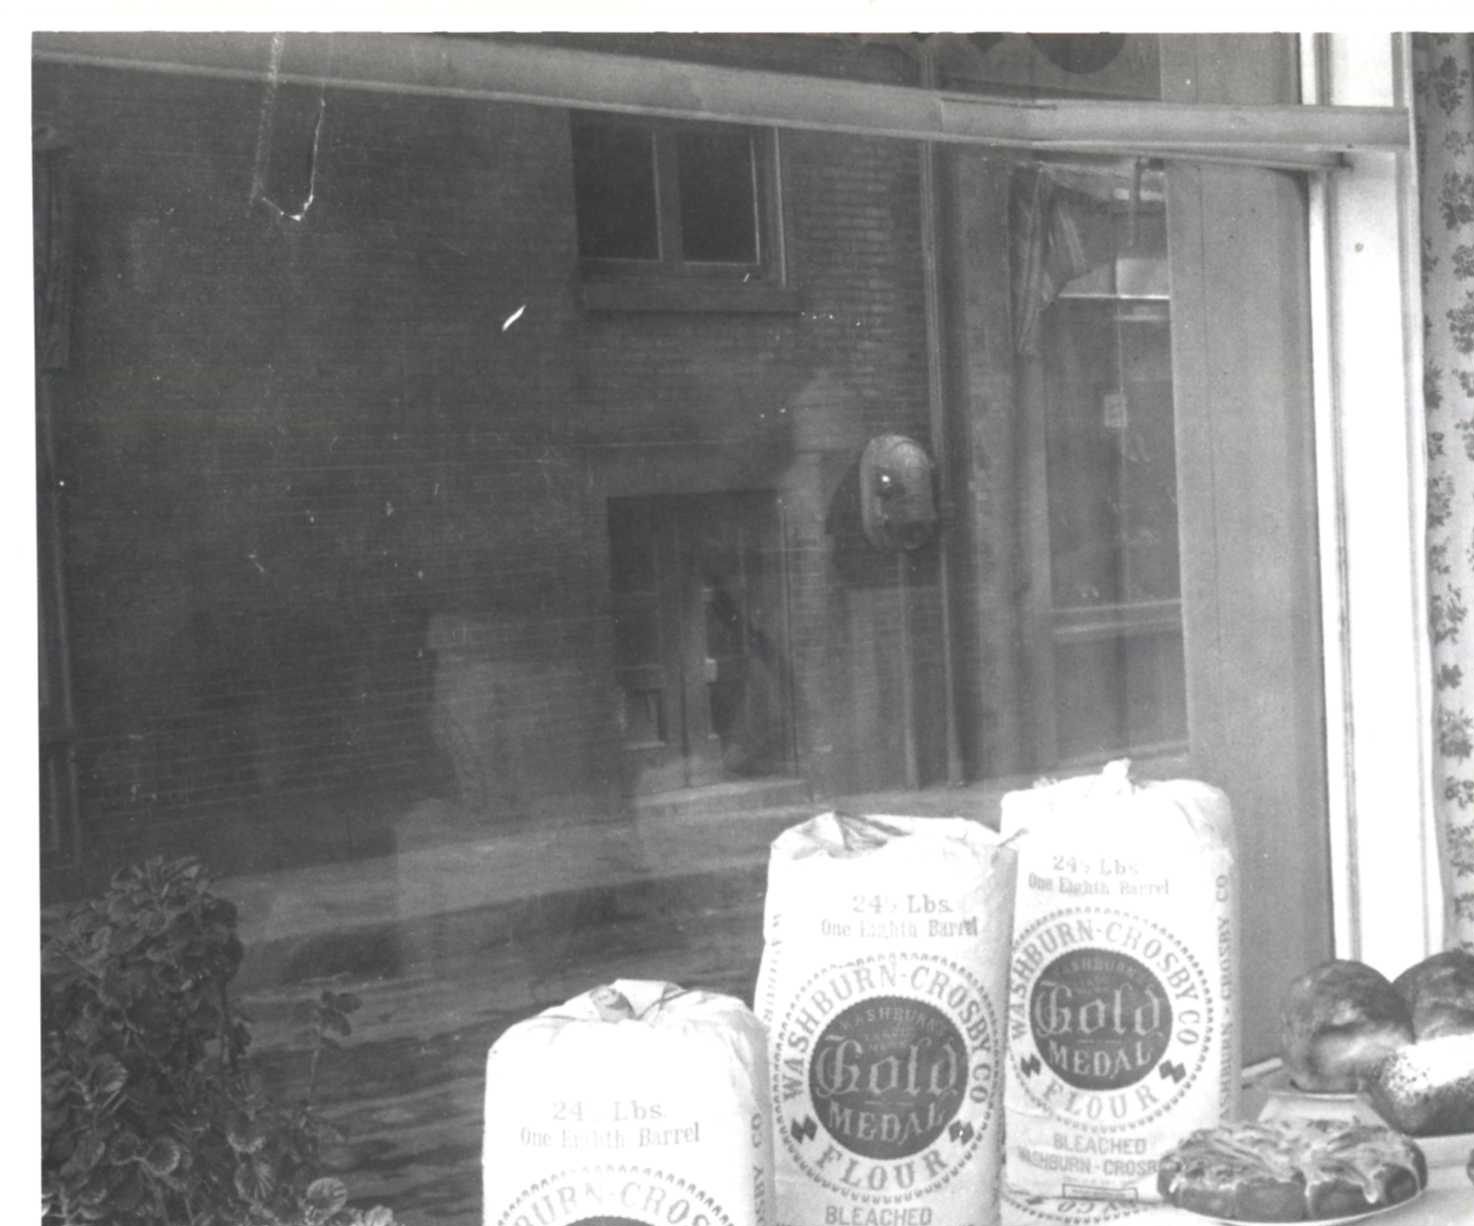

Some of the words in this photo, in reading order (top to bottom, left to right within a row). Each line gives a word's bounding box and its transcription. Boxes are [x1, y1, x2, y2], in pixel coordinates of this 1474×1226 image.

[1034, 981, 1164, 1036] Gold
[815, 1035, 961, 1097] Gold
[1049, 1041, 1157, 1079] MEDAL
[1042, 1083, 1158, 1119] FLOUR
[638, 1120, 701, 1149] Barrel
[828, 1101, 948, 1144] MEDAL
[1053, 1134, 1147, 1155] BLEACHED
[816, 1145, 949, 1191] FLOUR
